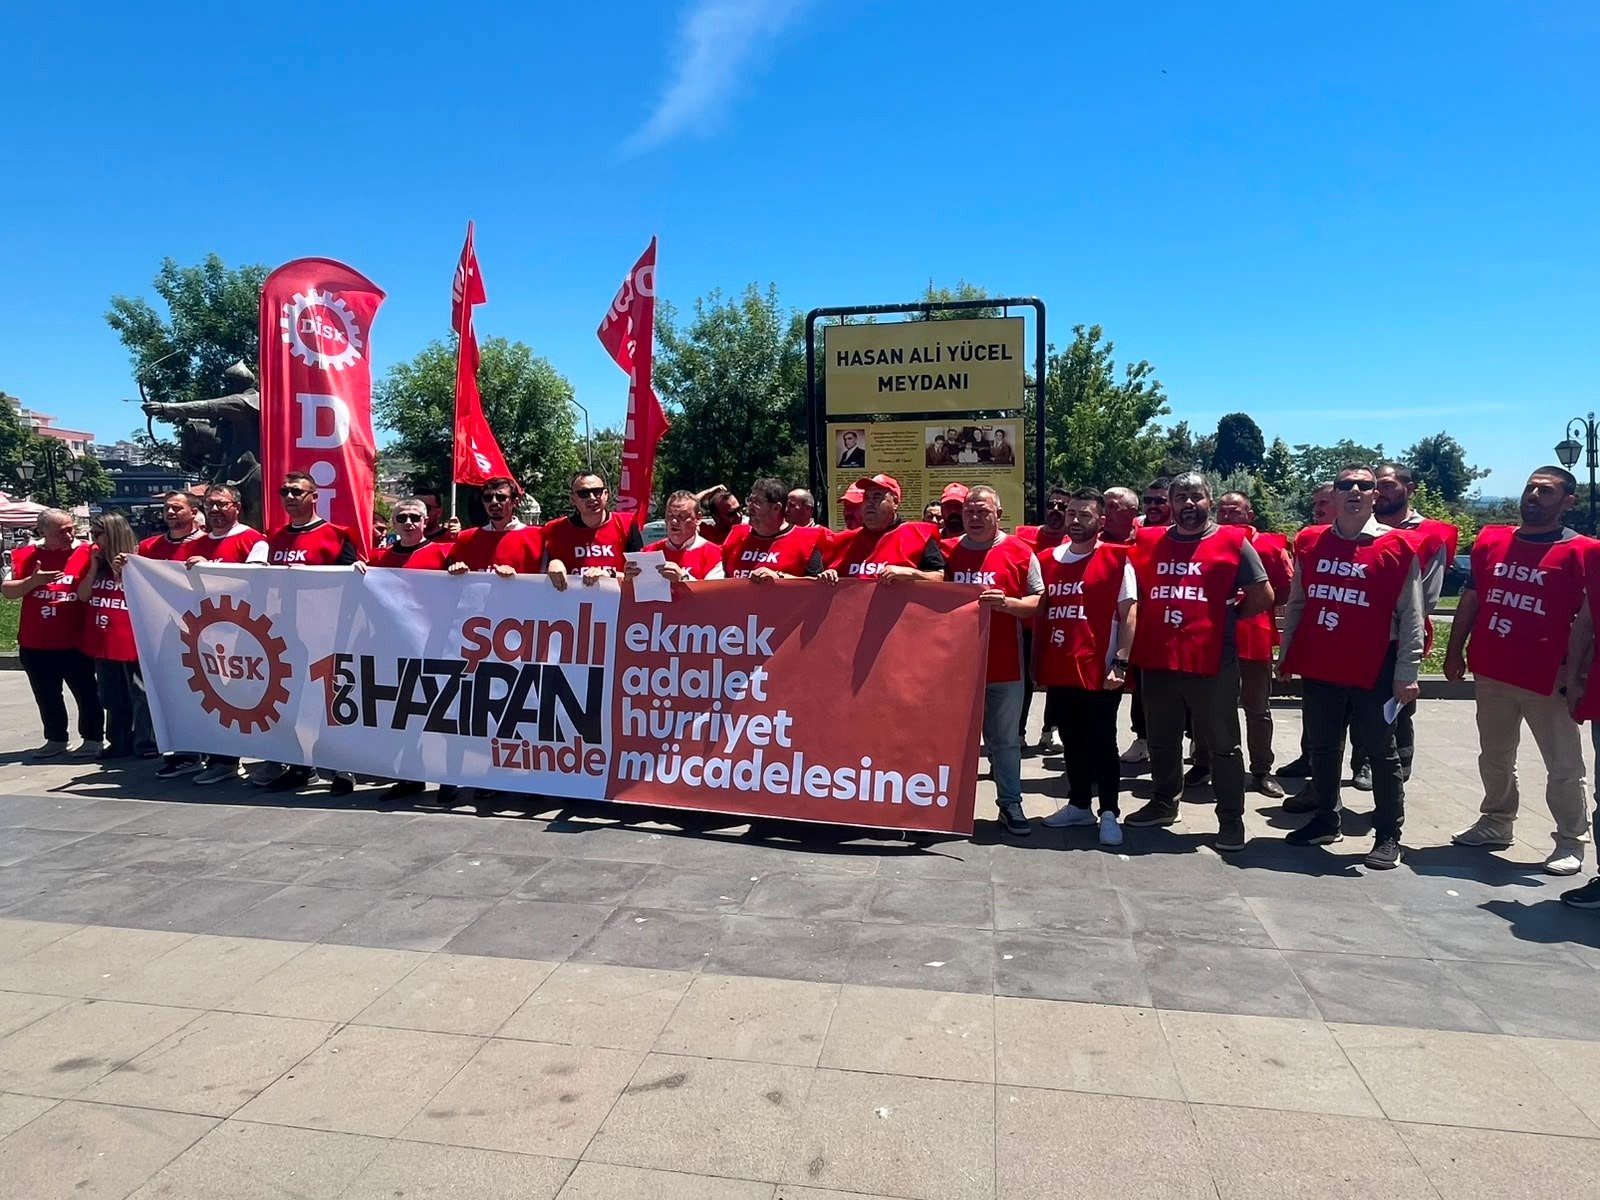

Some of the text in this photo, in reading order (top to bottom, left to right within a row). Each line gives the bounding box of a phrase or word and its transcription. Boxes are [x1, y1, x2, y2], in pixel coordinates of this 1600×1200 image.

[837, 340, 1012, 367] HASAN ALİ YÜCEL
[878, 373, 969, 392] MEYDANI
[274, 548, 307, 562] DİSK
[574, 543, 614, 558] DİSK
[741, 548, 780, 564] DİSK
[954, 568, 996, 585] DİSK
[1156, 559, 1203, 576] DİSK
[1316, 557, 1368, 579] DİSK
[1493, 561, 1548, 587] DİSK
[1048, 579, 1085, 597] DİSK
[1150, 585, 1208, 602] GENEL
[1307, 584, 1370, 608] GENEL
[89, 597, 129, 610] ENEL
[1047, 605, 1088, 620] ENEL
[1164, 605, 1183, 628] İŞ
[1317, 607, 1340, 631] İŞ
[1488, 612, 1512, 637] İŞ
[461, 602, 607, 673] şanlı
[624, 613, 775, 656] ekmek
[621, 656, 768, 702] adalet
[621, 698, 793, 754] hürriyet
[491, 736, 607, 777] izinde
[618, 743, 951, 808] mücadelesine!
